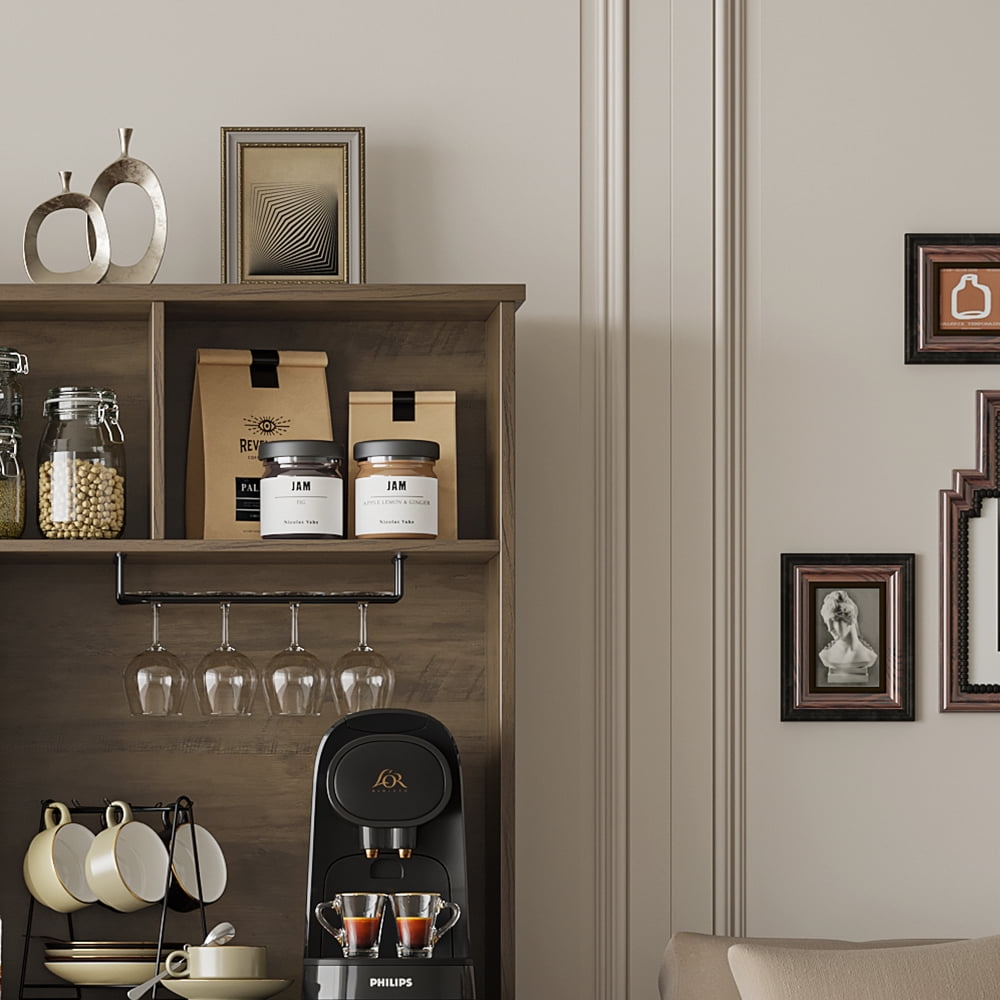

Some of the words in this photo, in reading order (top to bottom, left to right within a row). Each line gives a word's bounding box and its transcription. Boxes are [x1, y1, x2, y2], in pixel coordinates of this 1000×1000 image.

[239, 438, 264, 453] REV
[291, 481, 311, 492] JAM
[386, 480, 407, 491] JAM
[369, 977, 413, 988] PHILIPS
